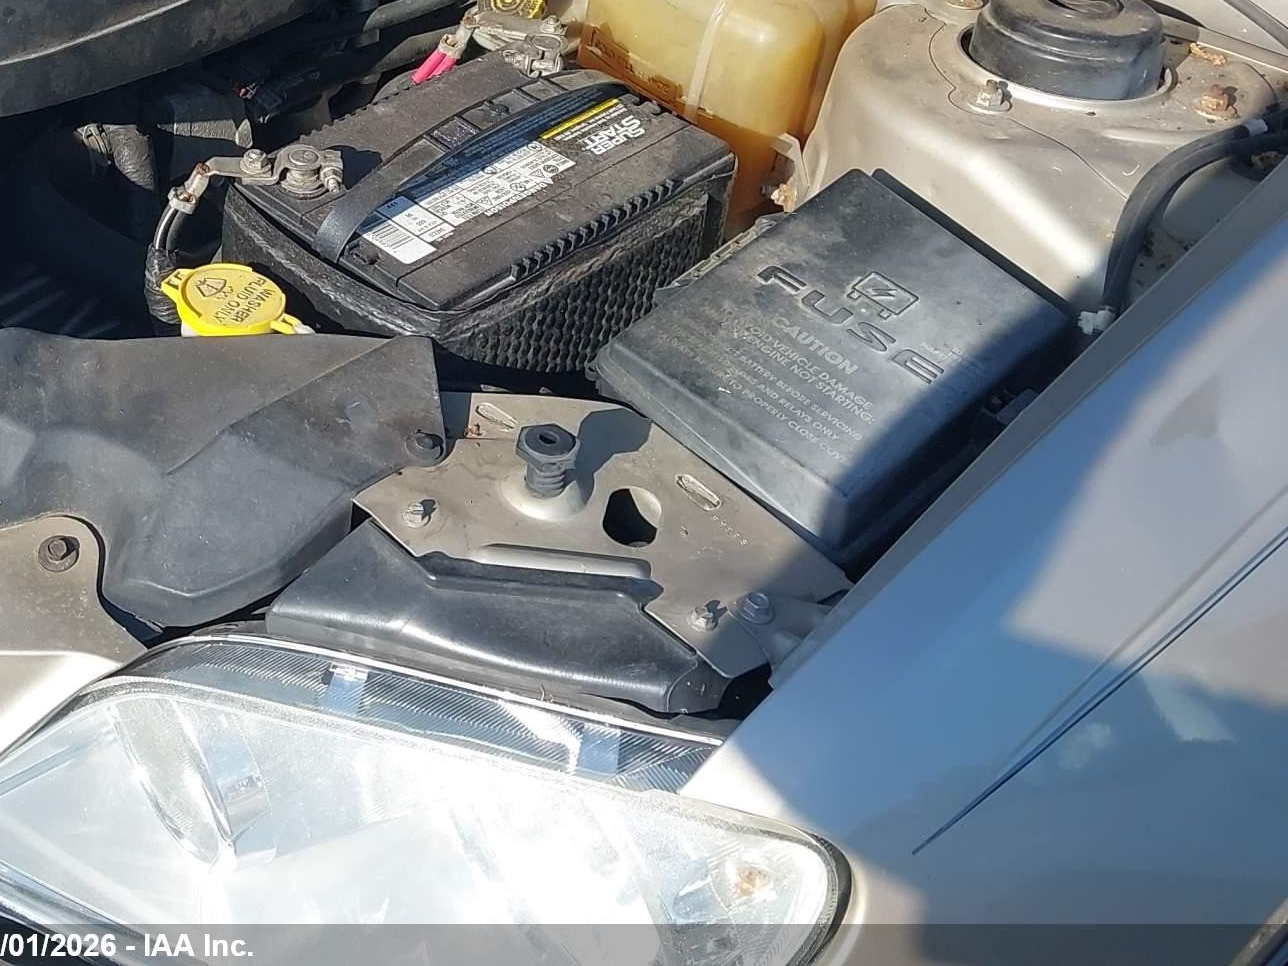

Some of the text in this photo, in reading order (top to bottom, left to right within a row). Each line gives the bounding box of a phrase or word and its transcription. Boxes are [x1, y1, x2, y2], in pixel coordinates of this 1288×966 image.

[583, 114, 642, 150] START
[591, 127, 646, 155] SUPER
[212, 276, 268, 323] FLUID ONLY
[231, 287, 276, 323] WASHER
[757, 265, 945, 385] FUSE
[772, 315, 859, 376] CAUTION
[742, 387, 788, 422] PROPERLY
[745, 334, 791, 367] ENGINE
[790, 364, 819, 384] NOT
[815, 380, 876, 426] STARTING:
[773, 339, 820, 375] VEHICLE
[818, 371, 874, 412] DAMAGE
[757, 383, 840, 441] AND RELAYS ONLY
[775, 379, 812, 406] BEFORE
[810, 403, 864, 442] SERVICING
